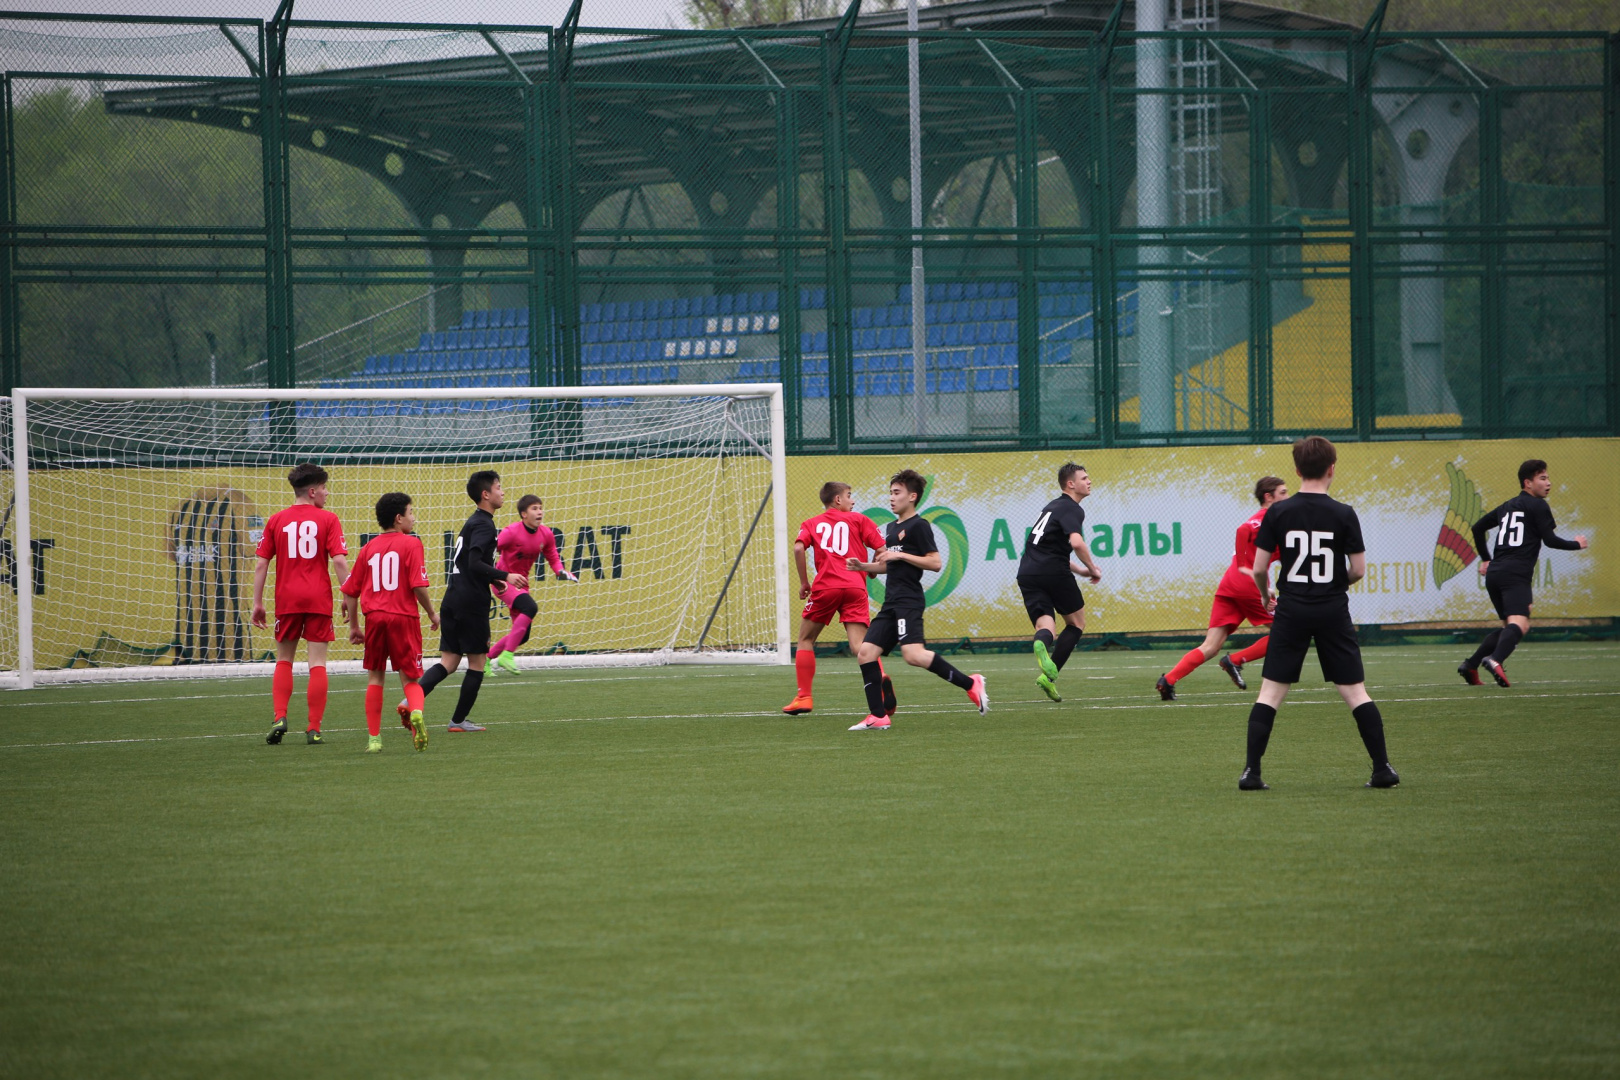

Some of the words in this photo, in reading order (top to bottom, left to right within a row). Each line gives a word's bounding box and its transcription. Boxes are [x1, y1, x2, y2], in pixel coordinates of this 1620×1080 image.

[283, 520, 318, 559] 18
[815, 521, 849, 557] 20
[985, 518, 1182, 561] Аалы
[1498, 511, 1525, 547] 15
[367, 551, 400, 593] 10
[1285, 530, 1334, 584] 25
[897, 618, 907, 636] 8
